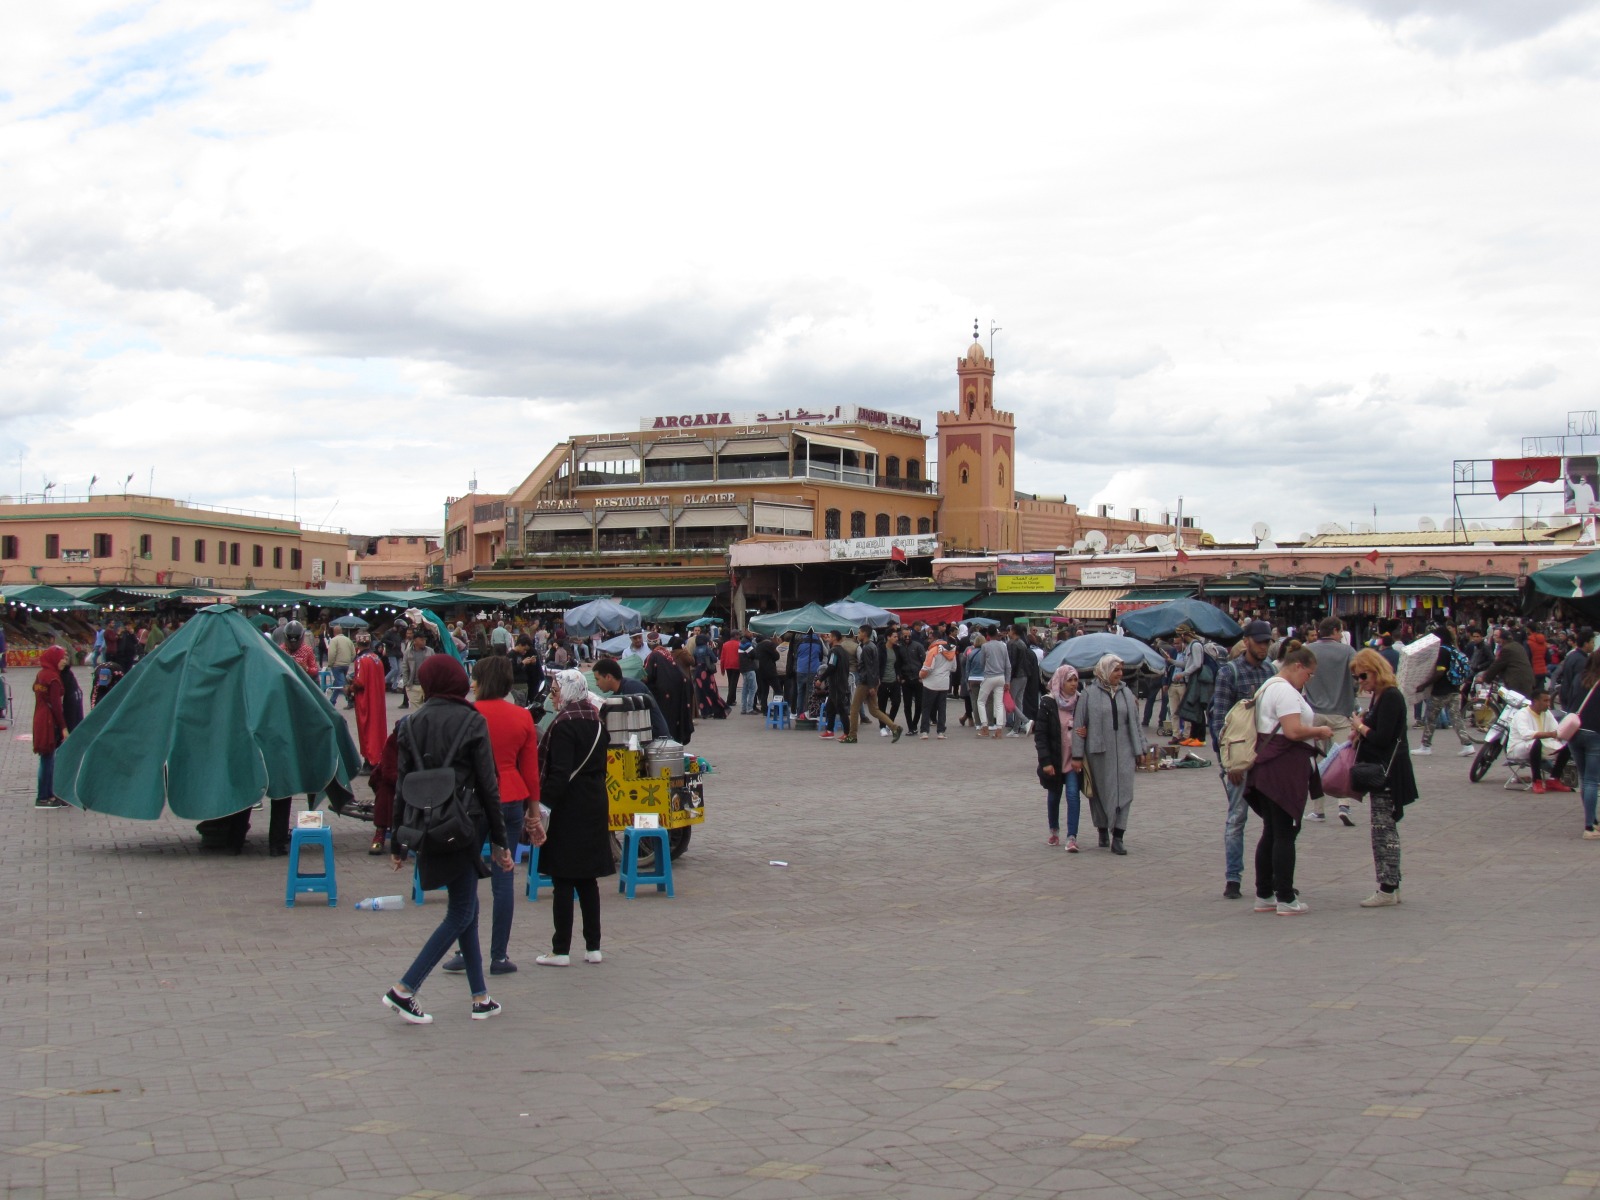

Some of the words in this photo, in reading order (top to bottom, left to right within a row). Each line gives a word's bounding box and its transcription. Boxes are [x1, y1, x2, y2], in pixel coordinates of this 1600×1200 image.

[653, 412, 732, 428] ARGANA
[536, 499, 579, 510] ARGANA
[595, 495, 670, 508] RESTAURANT
[683, 492, 736, 504] GLACIER
